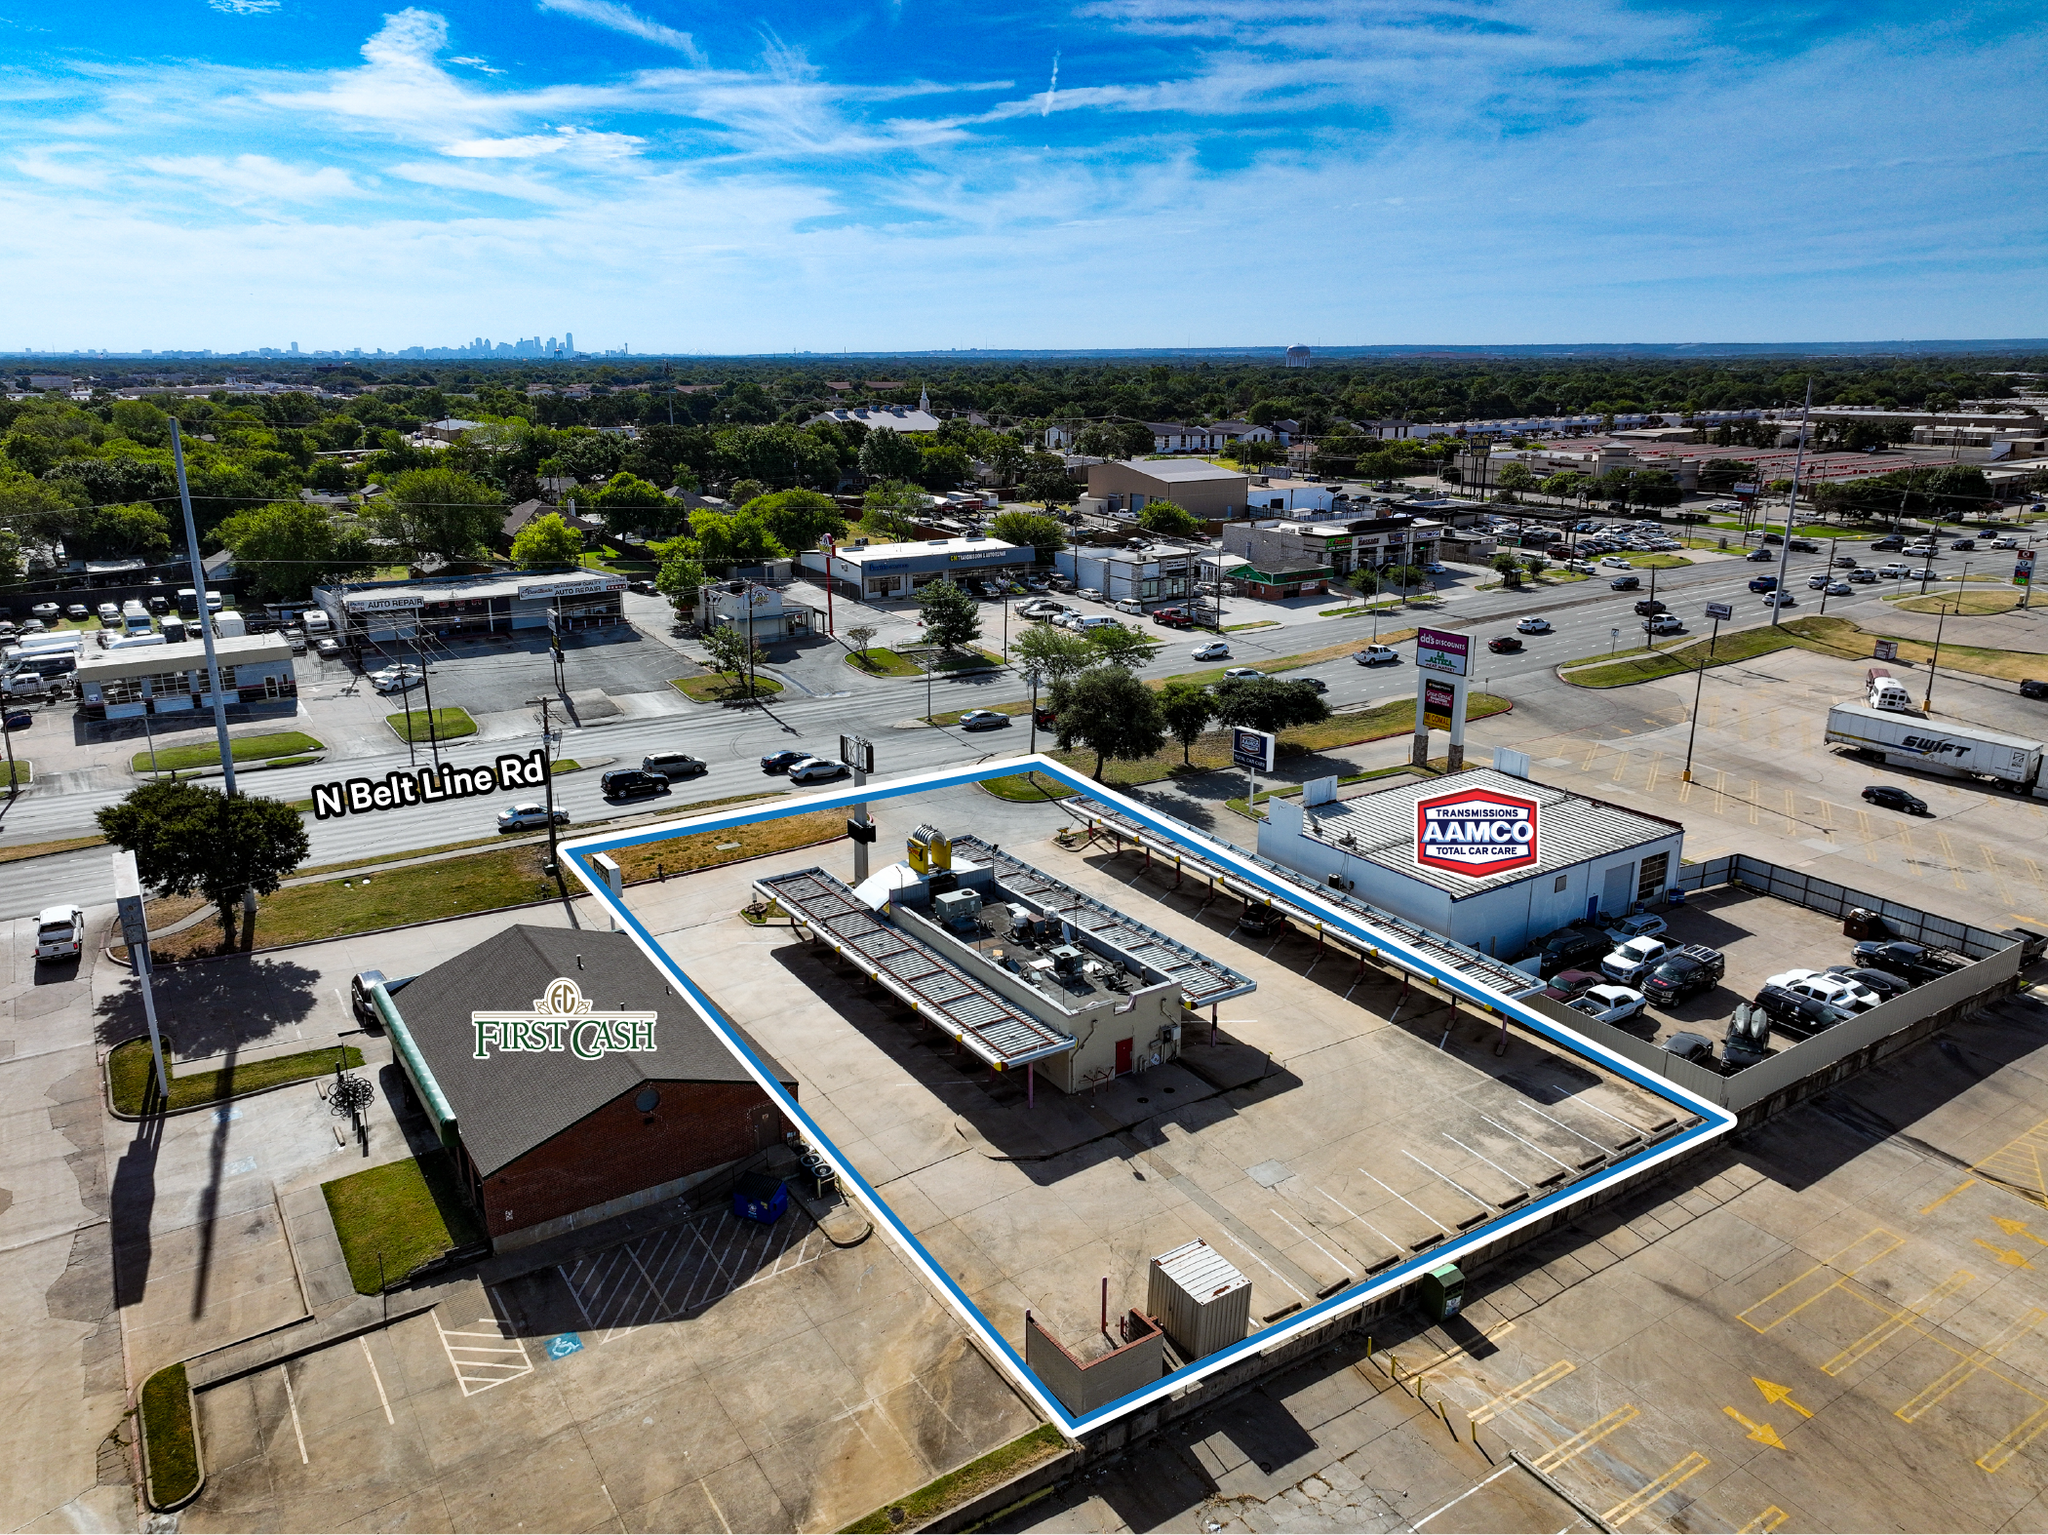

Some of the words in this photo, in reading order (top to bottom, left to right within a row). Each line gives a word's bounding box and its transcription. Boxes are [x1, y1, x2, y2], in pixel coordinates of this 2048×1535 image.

[555, 588, 574, 596] AUTO
[575, 585, 602, 593] REPAIR
[367, 601, 390, 609] AUTO
[392, 598, 422, 607] REPAIR
[1435, 639, 1465, 650] DISCOUNTS
[1902, 735, 1973, 757] SWIFT
